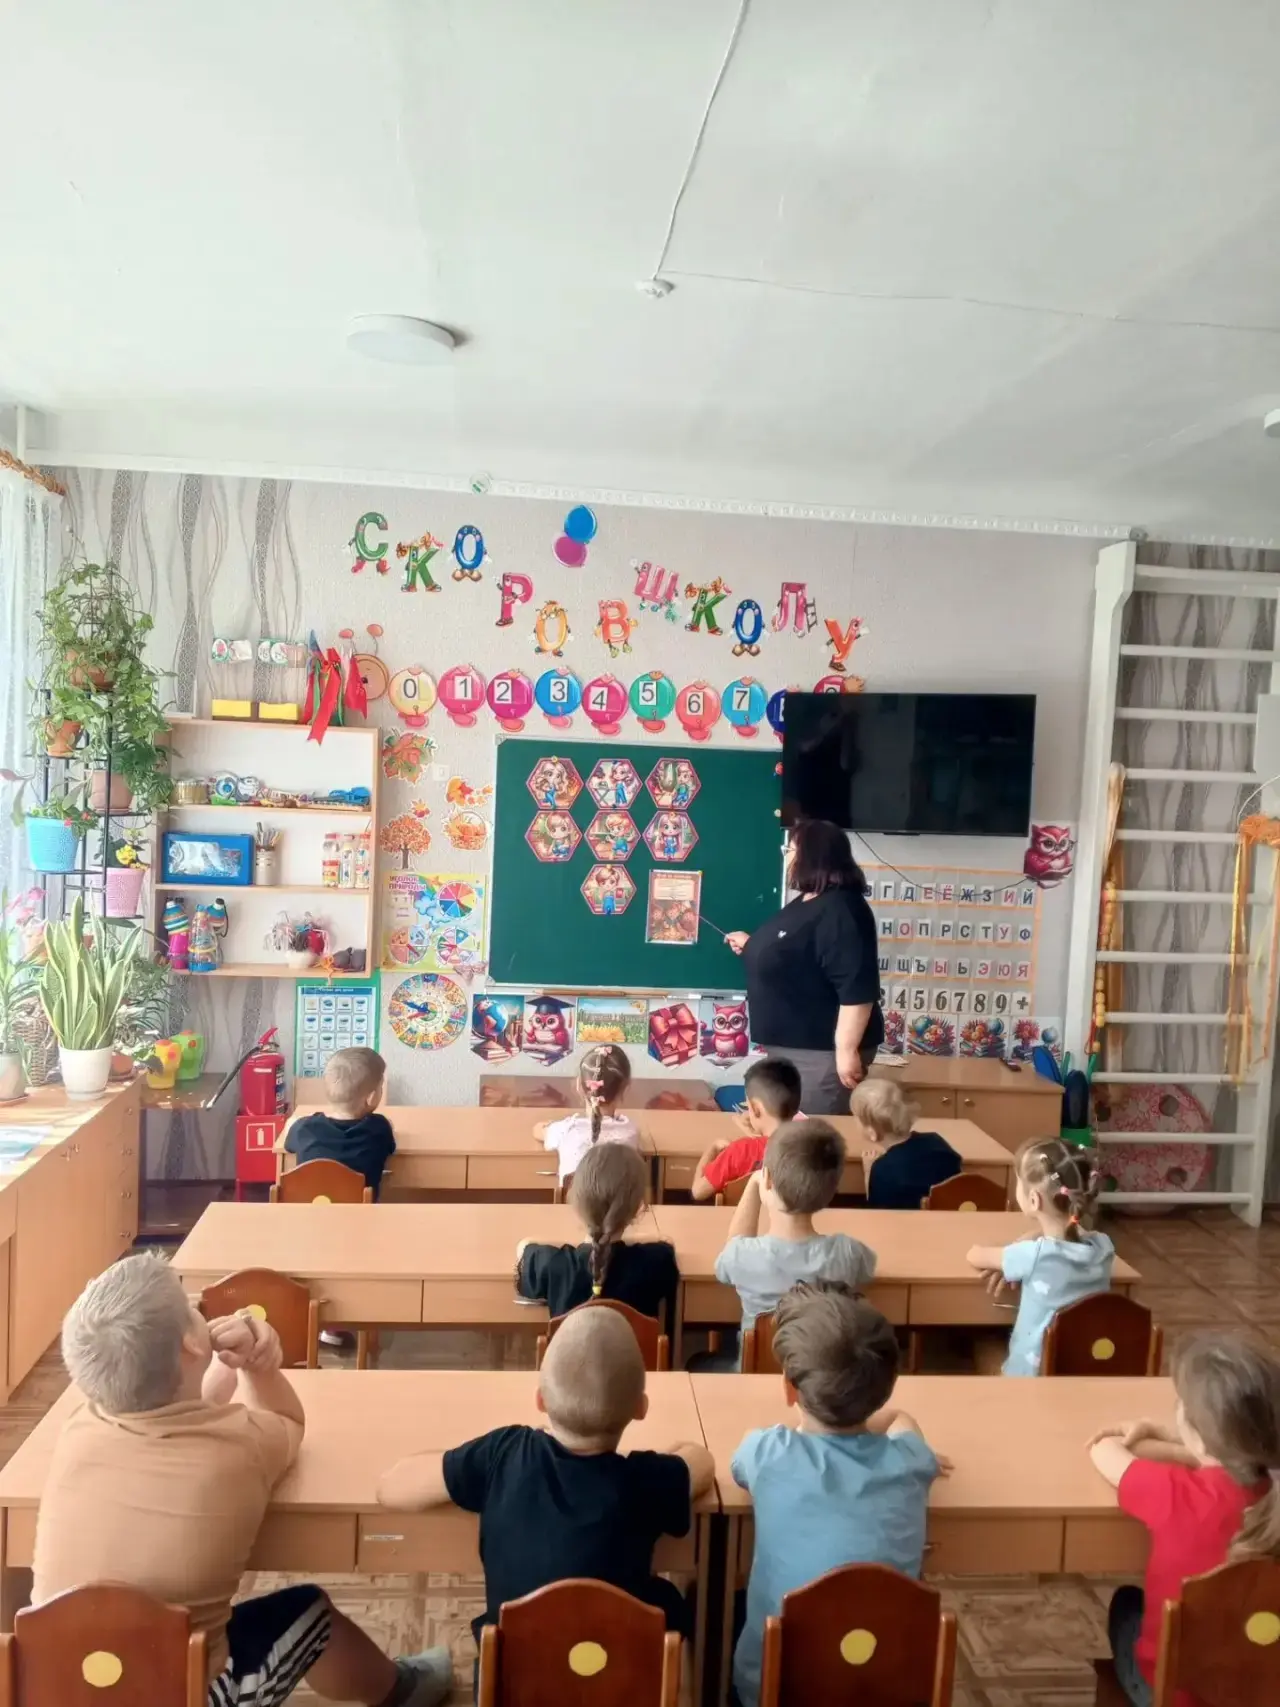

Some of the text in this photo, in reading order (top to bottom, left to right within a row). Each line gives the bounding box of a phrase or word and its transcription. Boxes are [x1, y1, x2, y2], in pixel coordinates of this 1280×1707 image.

[348, 511, 868, 672] СКОРО В ШКОЛУ
[403, 678, 748, 714] 0 1 2 3 4 5 6 7
[883, 885, 893, 898] Г
[904, 887, 914, 902] Д
[924, 888, 933, 900] Е
[943, 885, 952, 900] Ё
[960, 888, 974, 902] Ж
[982, 889, 992, 902] З
[1004, 890, 1015, 903] И
[1023, 888, 1033, 905] Й
[882, 921, 1031, 941] Н О П Р С Т У Ф
[899, 959, 909, 973] Щ
[915, 959, 926, 973] Ъ
[935, 961, 947, 973] Ы
[957, 962, 968, 975] Ь
[978, 962, 989, 976] Э
[998, 964, 1010, 977] Ю
[1018, 965, 1029, 978] Я
[895, 988, 907, 1009] 4
[913, 989, 925, 1010] 5
[935, 990, 948, 1011] 6
[954, 992, 966, 1012] 7
[973, 993, 986, 1013] 8
[995, 994, 1008, 1014] 9
[1017, 996, 1028, 1010] +
